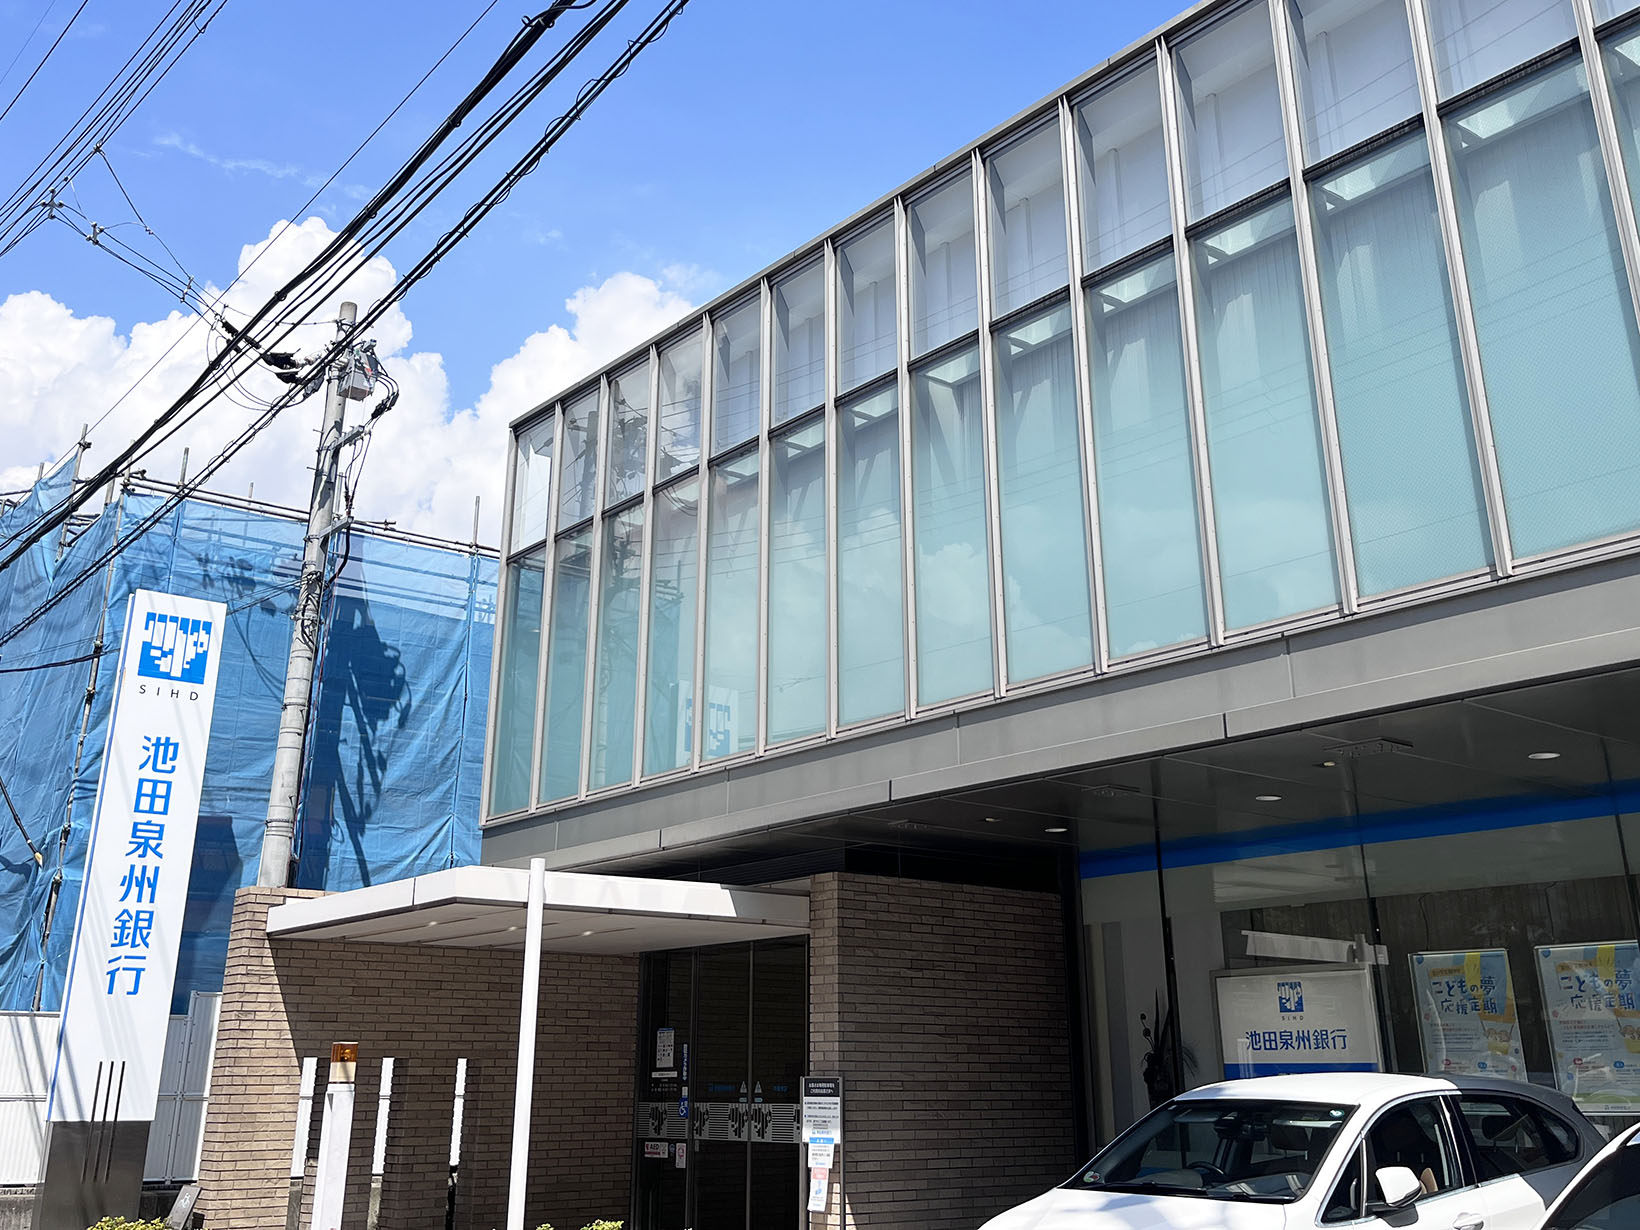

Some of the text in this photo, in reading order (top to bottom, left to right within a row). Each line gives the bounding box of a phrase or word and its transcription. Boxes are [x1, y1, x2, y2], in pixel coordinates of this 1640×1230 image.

[139, 684, 200, 702] SIHD
[106, 735, 180, 996] 池田泉州銀行
[1431, 976, 1496, 997] こどもの夢
[1561, 969, 1633, 993] こどもの夢
[1440, 997, 1498, 1015] 応援定期
[1571, 992, 1636, 1012] 応援定期
[1245, 1028, 1347, 1051] 池田泉州銀行
[650, 1143, 659, 1151] AED
